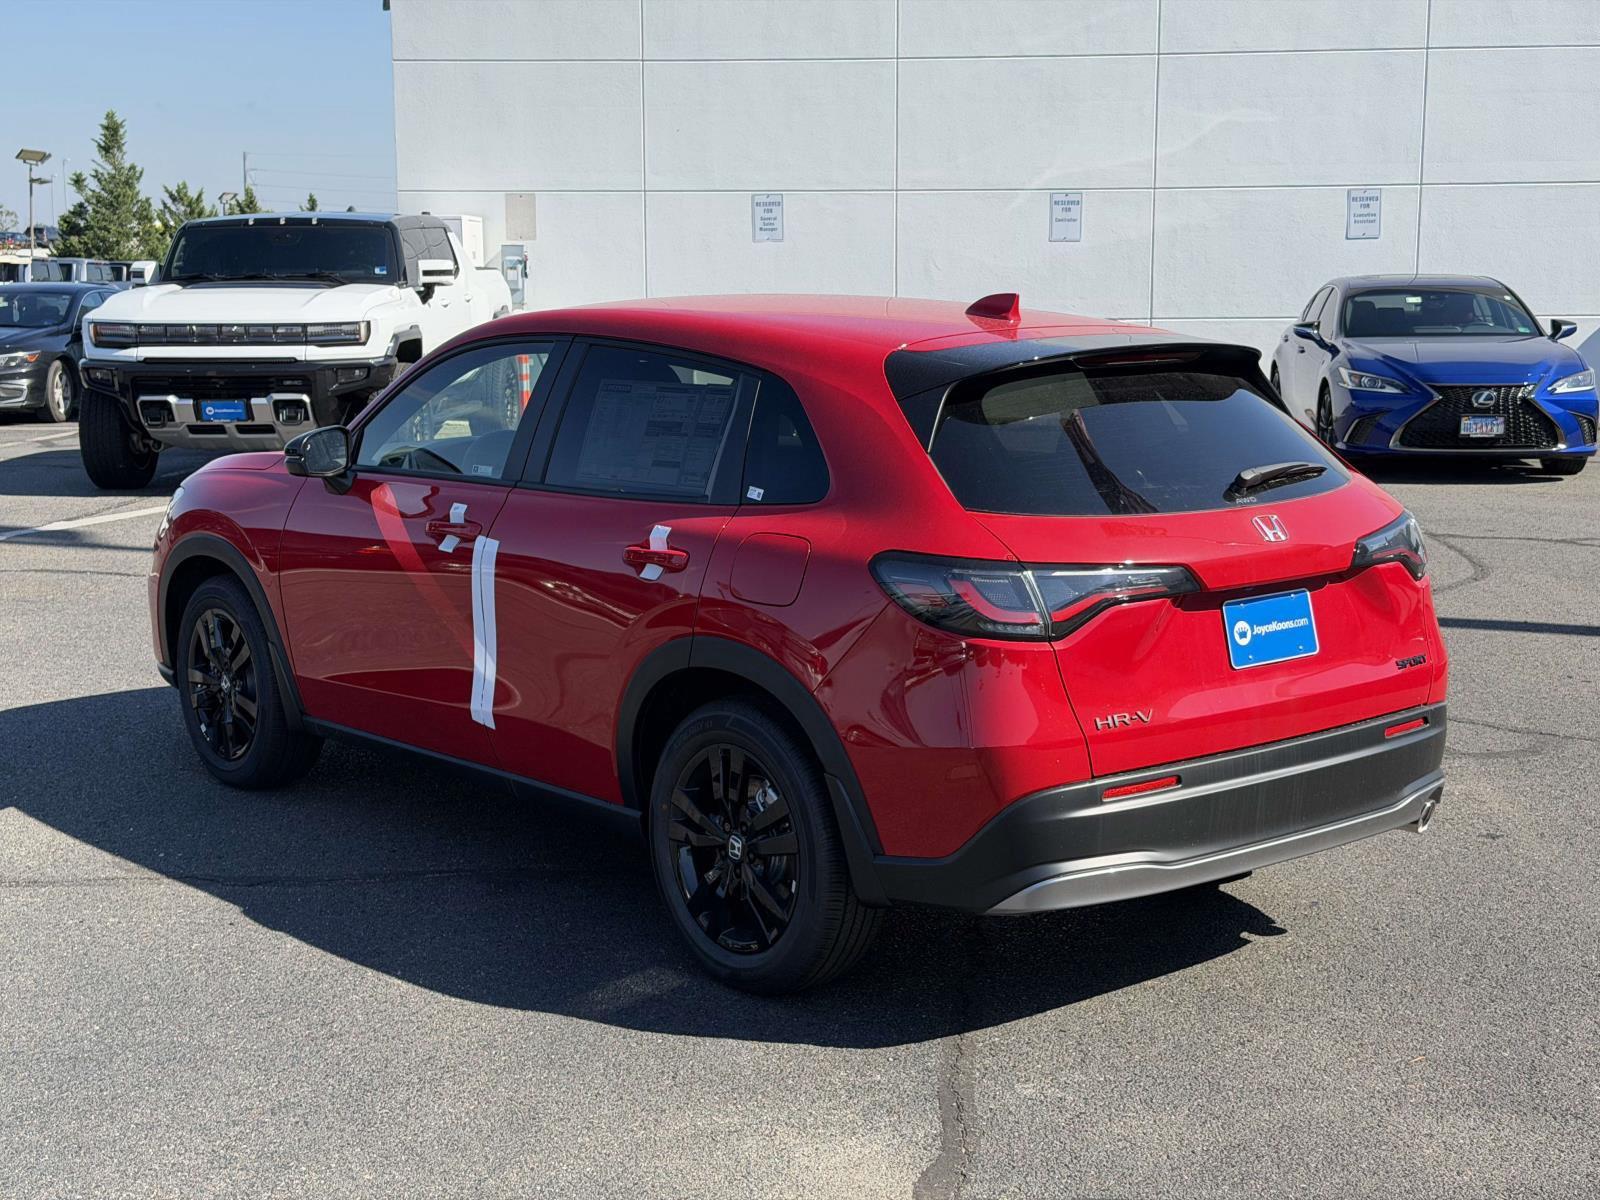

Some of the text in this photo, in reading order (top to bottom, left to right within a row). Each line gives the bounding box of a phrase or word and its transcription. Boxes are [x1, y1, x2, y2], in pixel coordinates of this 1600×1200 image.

[1236, 496, 1257, 504] AWD
[1252, 618, 1309, 636] JoyceKoons.com
[1395, 655, 1426, 670] SPORT
[1094, 709, 1153, 731] HR-V
